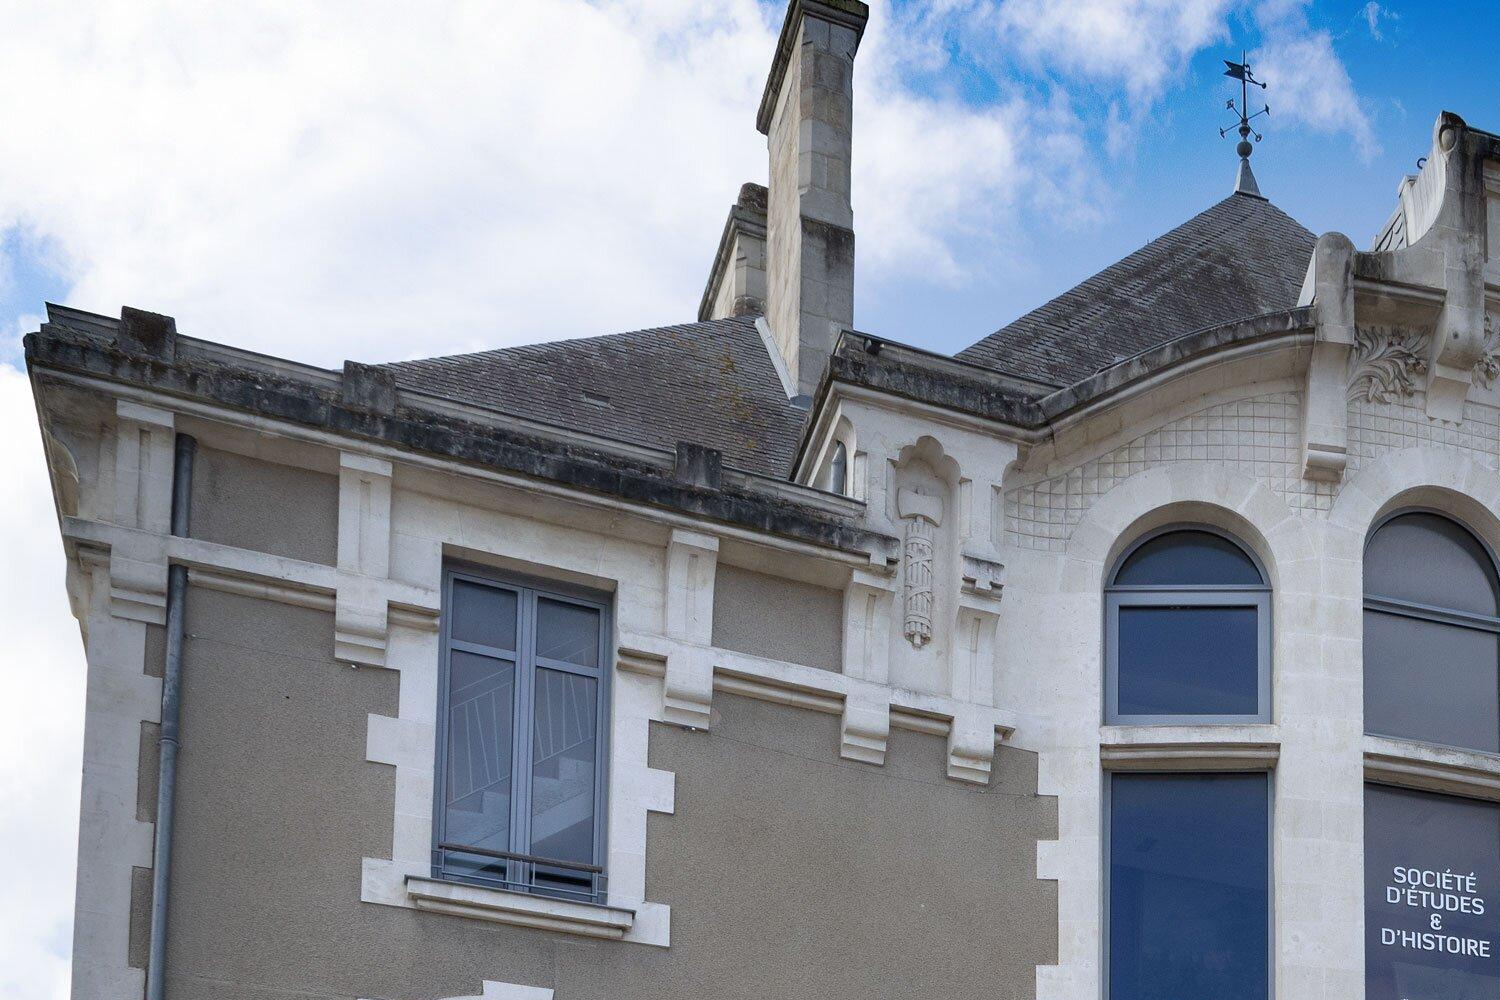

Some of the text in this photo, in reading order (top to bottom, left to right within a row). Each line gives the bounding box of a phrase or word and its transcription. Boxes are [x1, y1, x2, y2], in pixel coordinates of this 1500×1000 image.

[1393, 866, 1477, 893] SOCIÉTÉ
[1386, 885, 1485, 915] D'ÉTUDES
[1429, 914, 1442, 931] &
[1381, 927, 1491, 958] D'HISTOIRE
